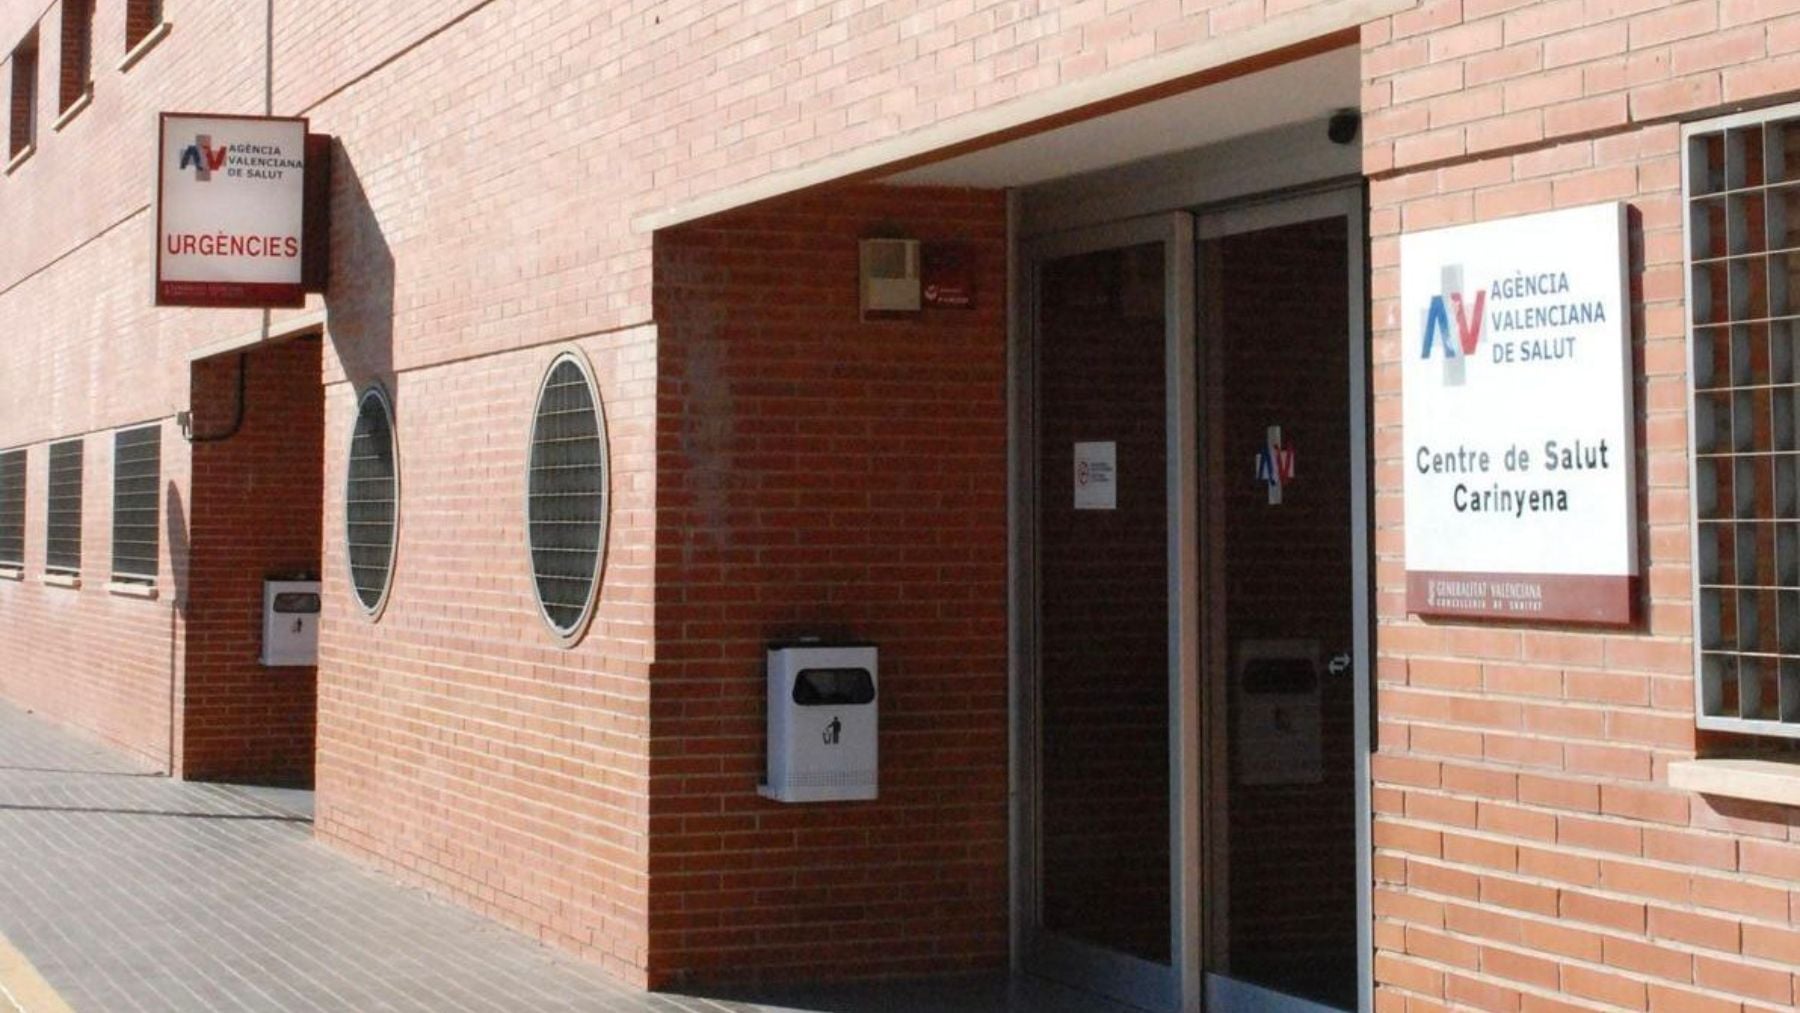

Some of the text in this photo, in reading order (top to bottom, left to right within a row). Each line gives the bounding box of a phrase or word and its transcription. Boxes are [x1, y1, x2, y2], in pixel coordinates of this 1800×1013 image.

[228, 144, 281, 156] AGÈNCIA
[228, 156, 303, 169] VALENCIANA
[228, 168, 283, 180] DE SALUT
[167, 229, 299, 258] URGÈNCIES
[1491, 270, 1570, 300] AGÈNCIA
[1491, 301, 1607, 332] VALENCIANA
[1493, 337, 1576, 364] DE SALUT
[1416, 438, 1609, 474] Centre de Salut
[1453, 482, 1568, 518] Carinyena
[1436, 580, 1542, 600] GENERALITAT VALENCIANA
